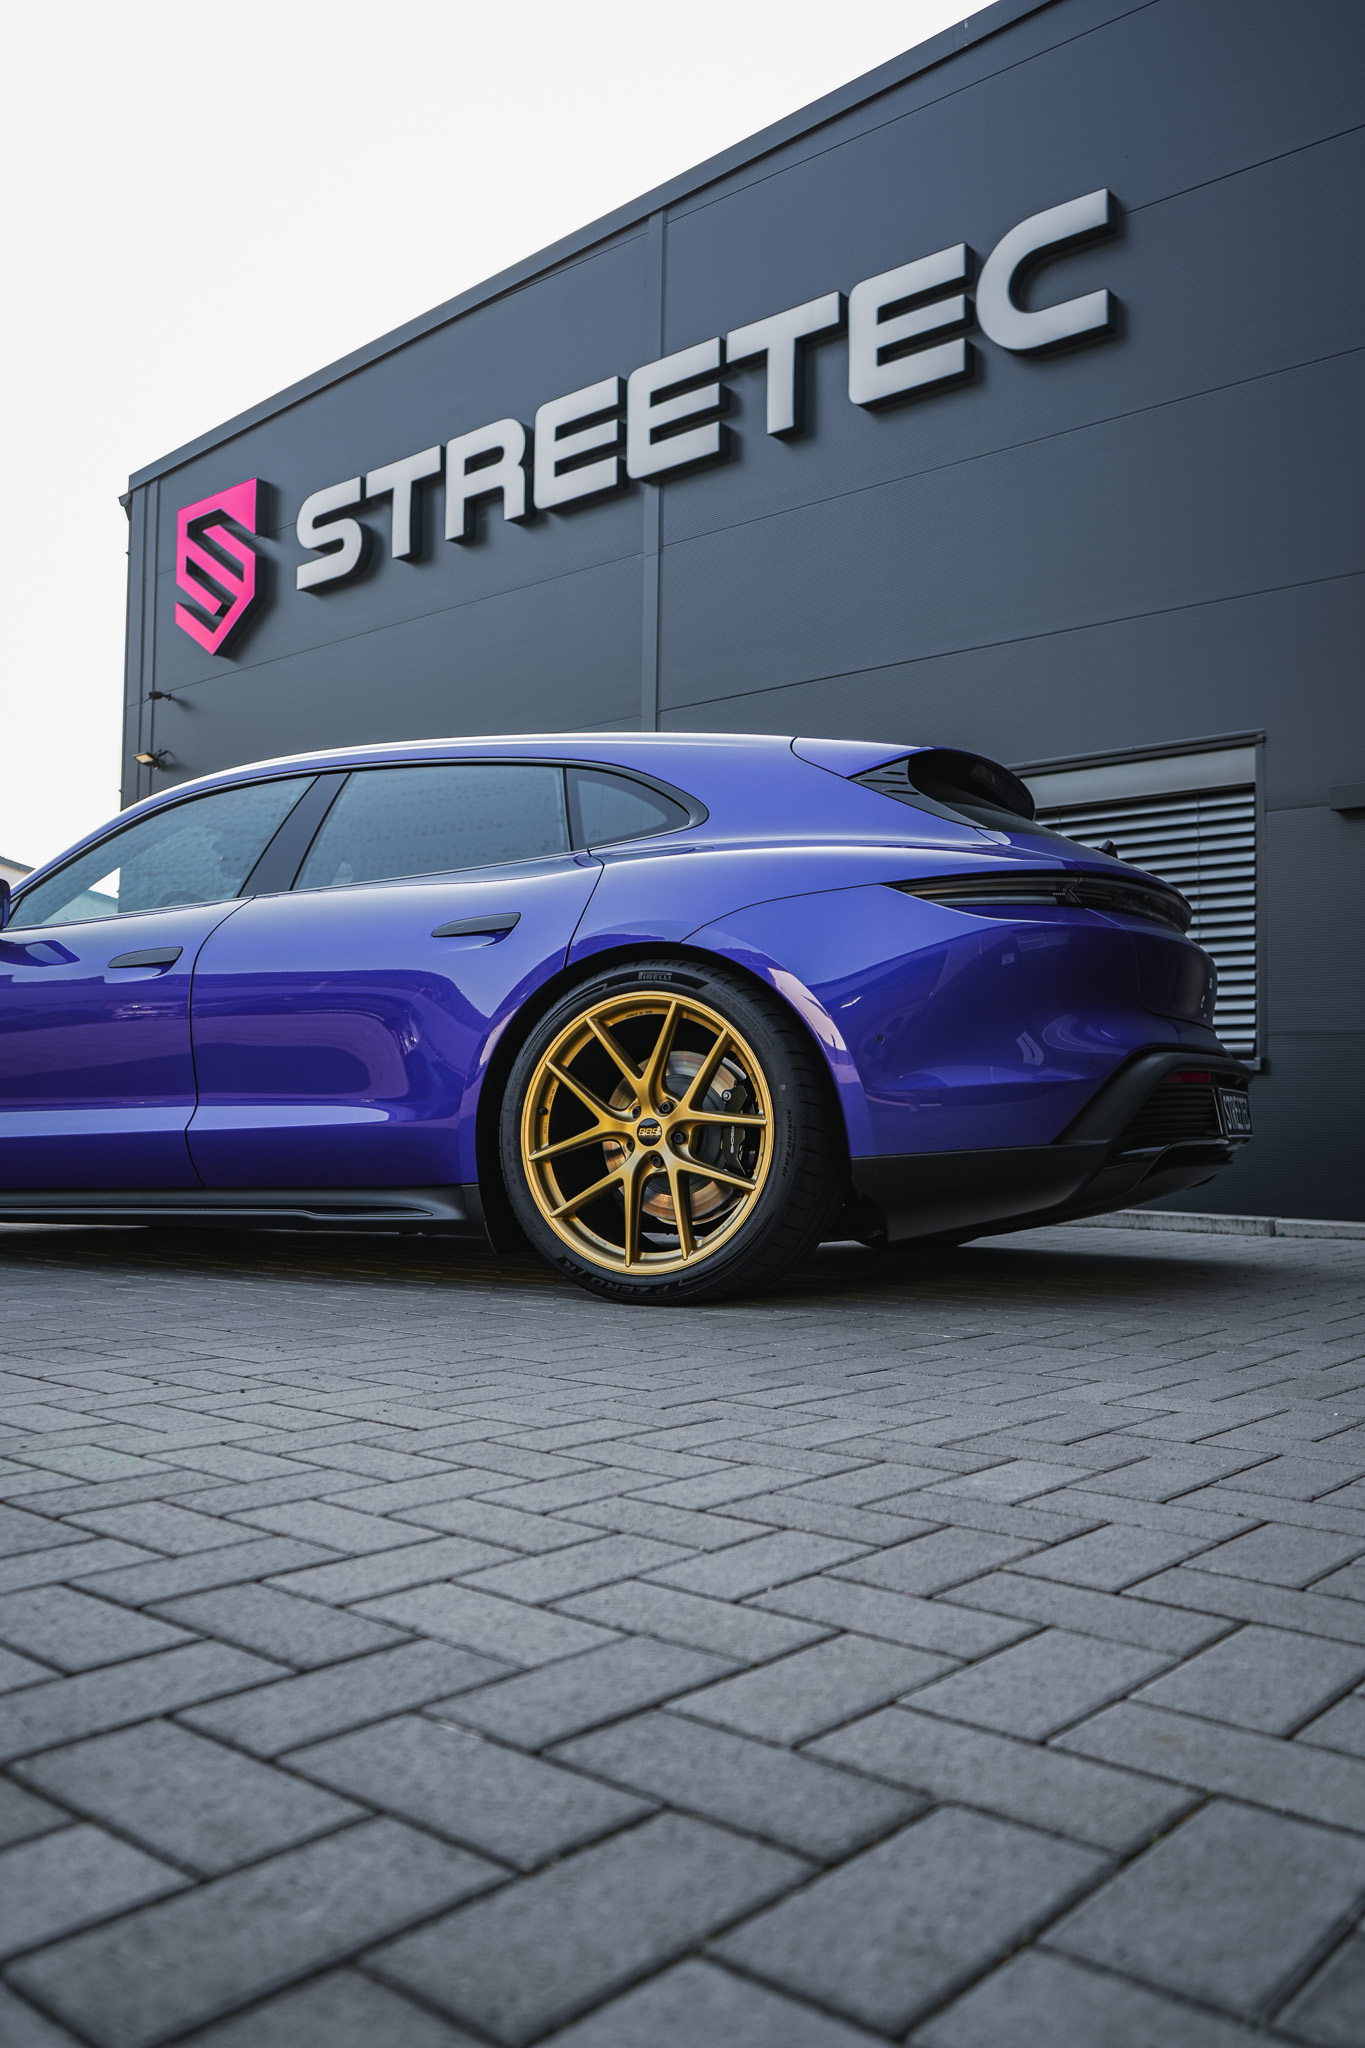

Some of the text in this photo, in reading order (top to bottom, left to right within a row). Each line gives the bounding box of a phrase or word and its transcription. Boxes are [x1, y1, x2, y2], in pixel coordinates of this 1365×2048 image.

[296, 187, 1111, 592] STREETEC
[638, 971, 673, 981] PIRELLI
[638, 1127, 661, 1136] BBS
